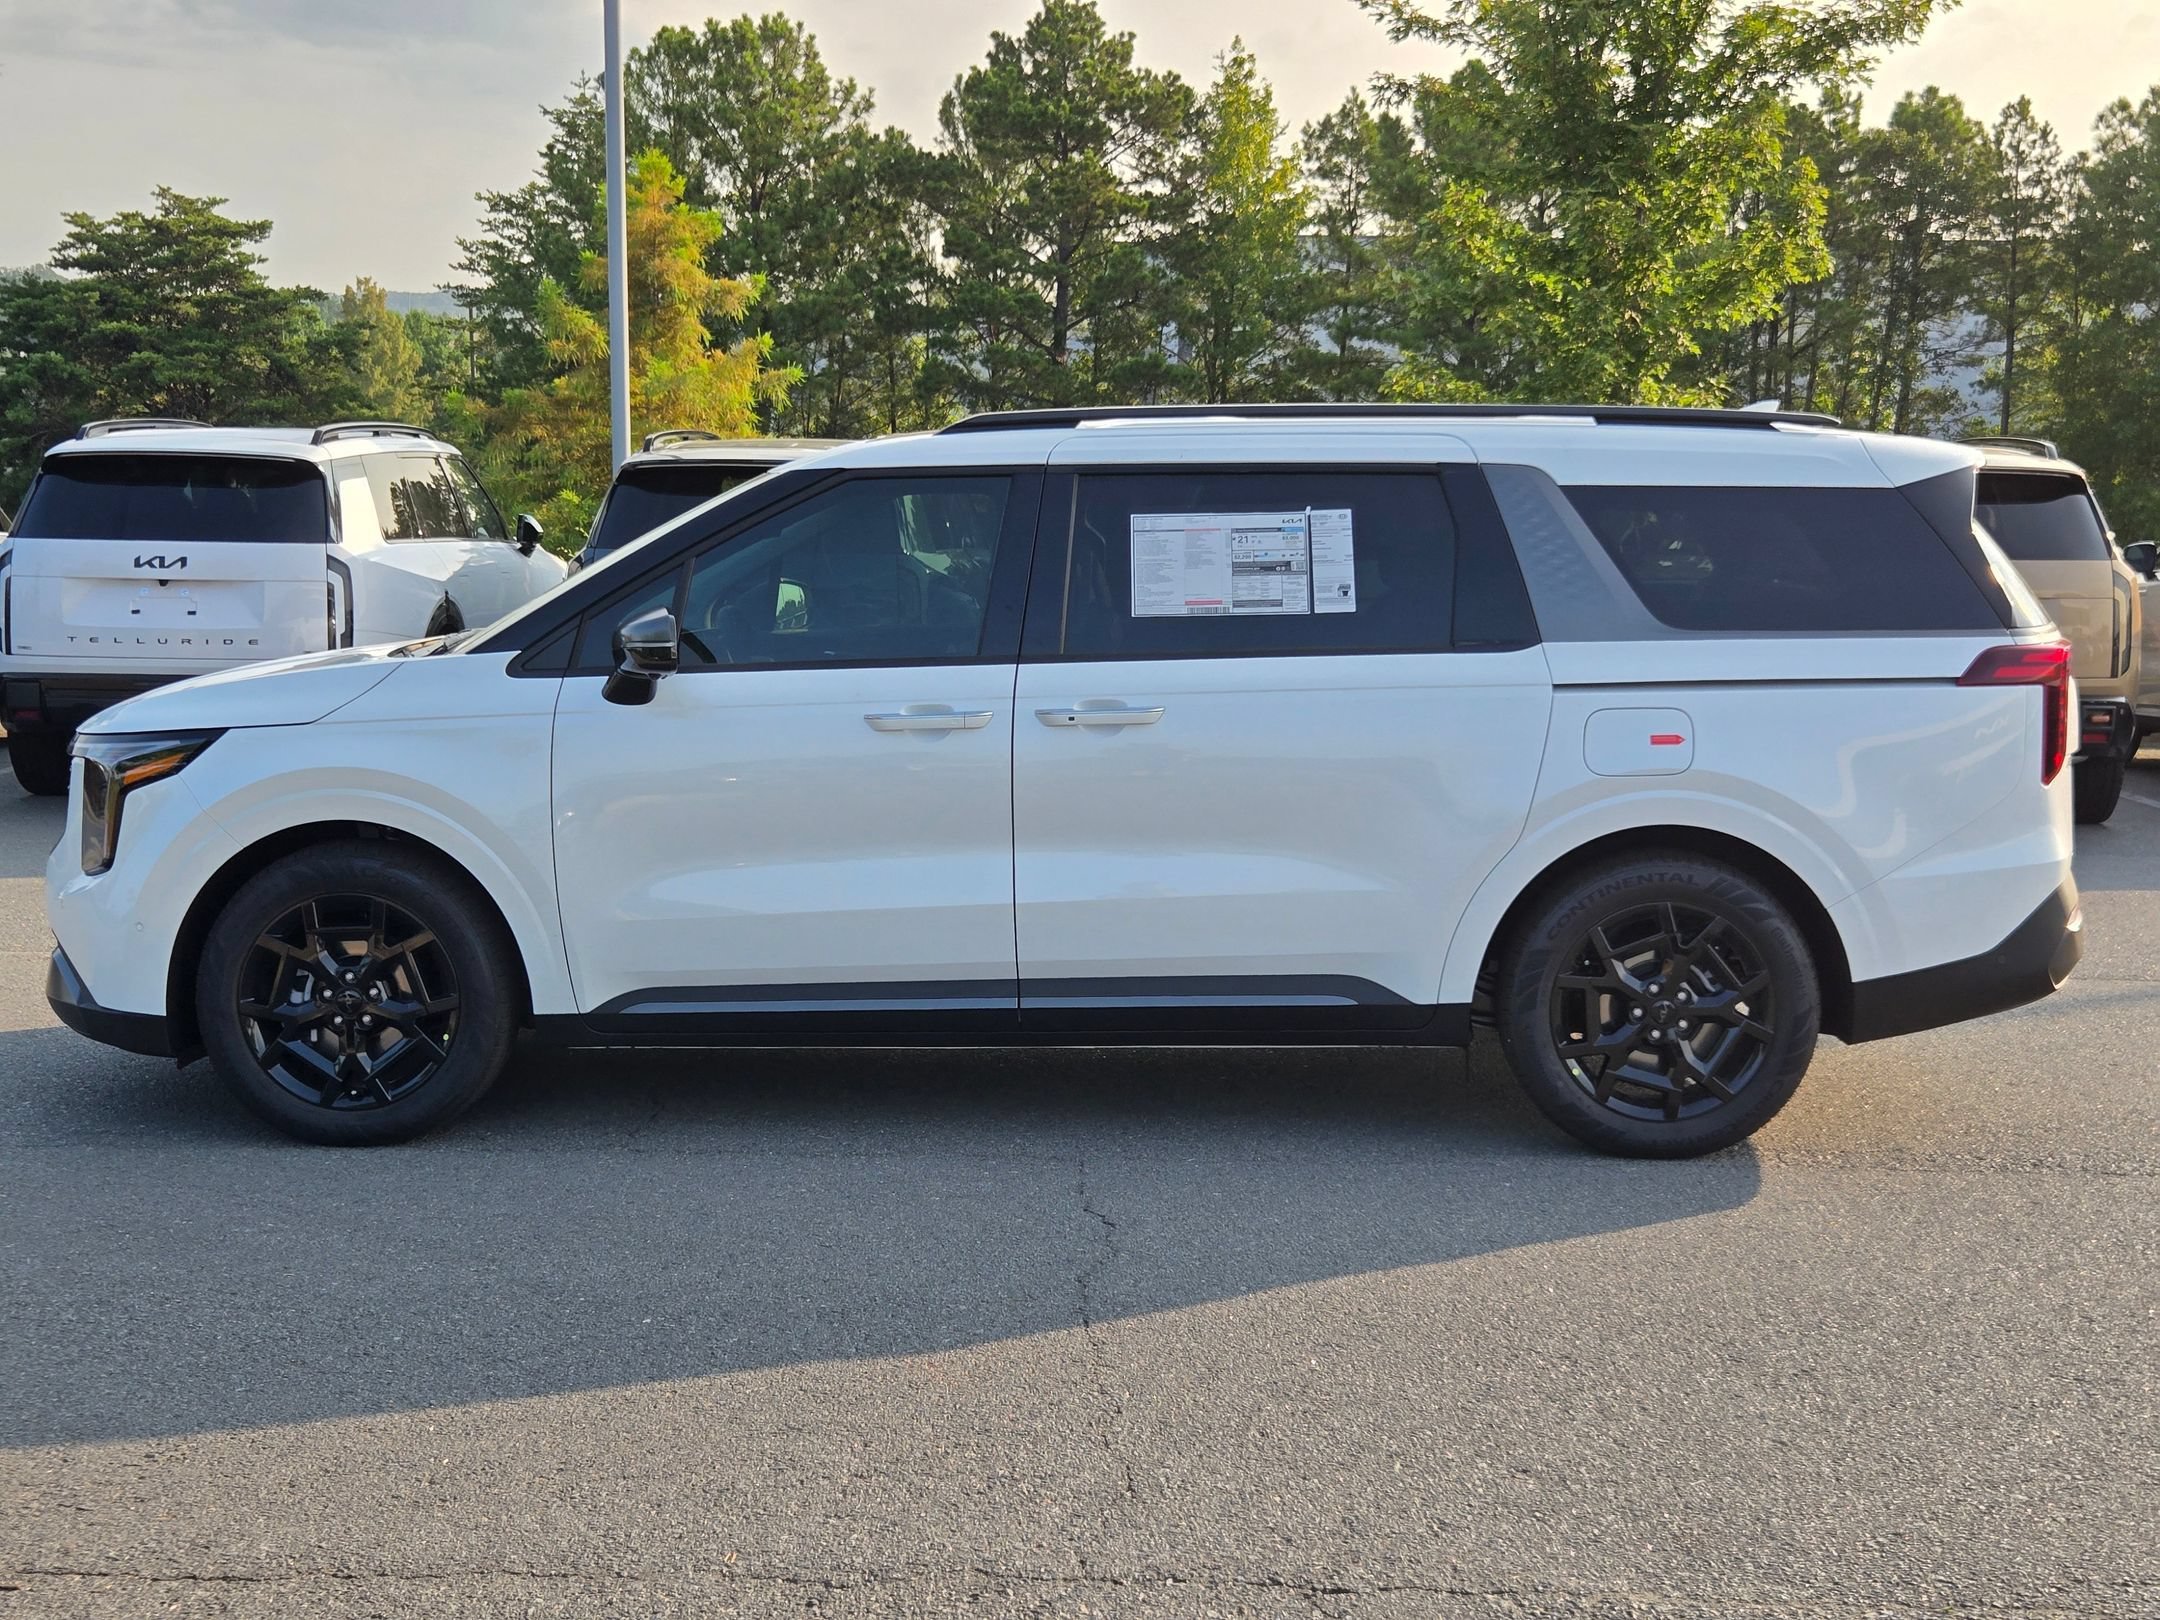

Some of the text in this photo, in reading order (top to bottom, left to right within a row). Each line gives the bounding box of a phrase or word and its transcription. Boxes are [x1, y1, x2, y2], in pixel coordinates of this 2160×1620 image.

[1237, 535, 1249, 544] 21
[133, 555, 188, 570] KIA
[67, 635, 260, 646] TELLURIDE
[1547, 871, 1700, 941] CONTINENTAL
